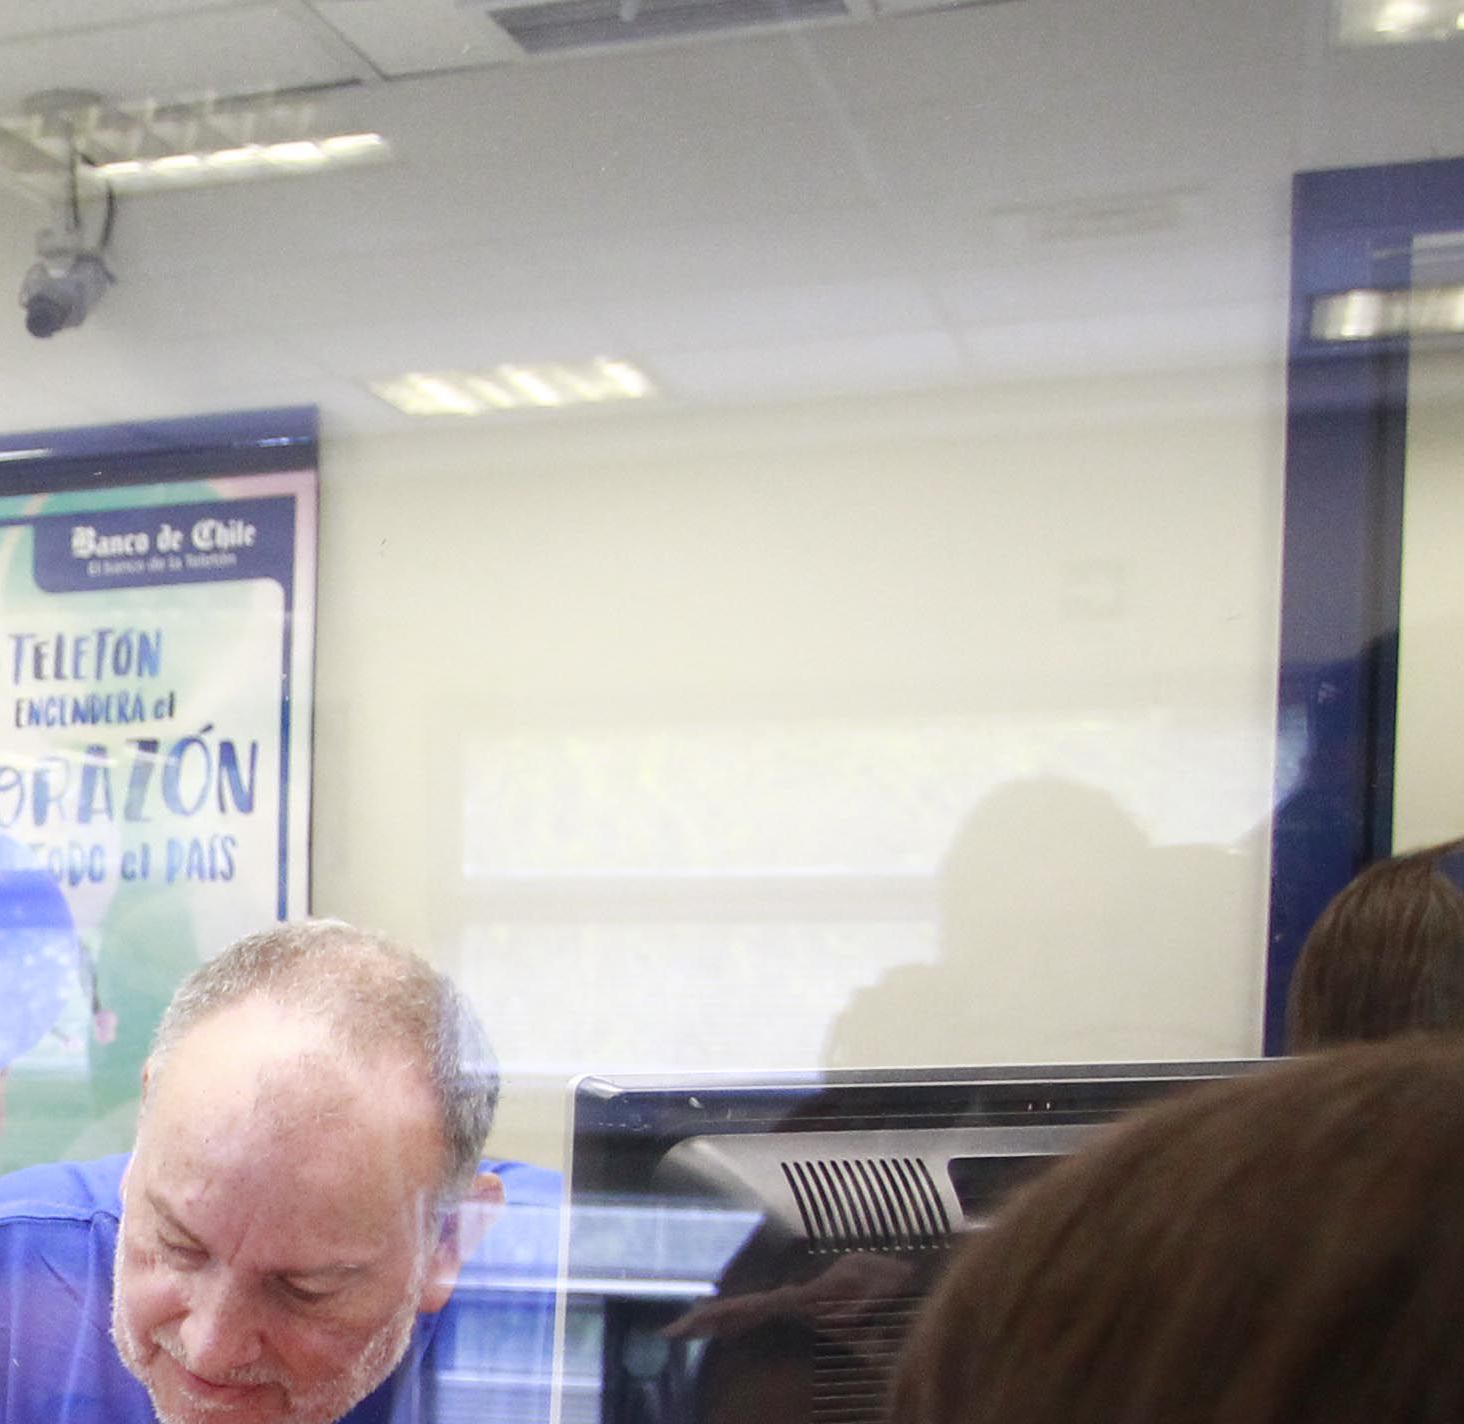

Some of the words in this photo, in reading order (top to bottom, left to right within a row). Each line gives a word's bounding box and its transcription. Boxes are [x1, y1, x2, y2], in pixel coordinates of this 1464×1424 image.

[72, 525, 149, 558] Banco
[156, 523, 184, 552] de
[191, 518, 257, 551] Chile
[153, 690, 176, 720] el
[120, 843, 151, 882] el
